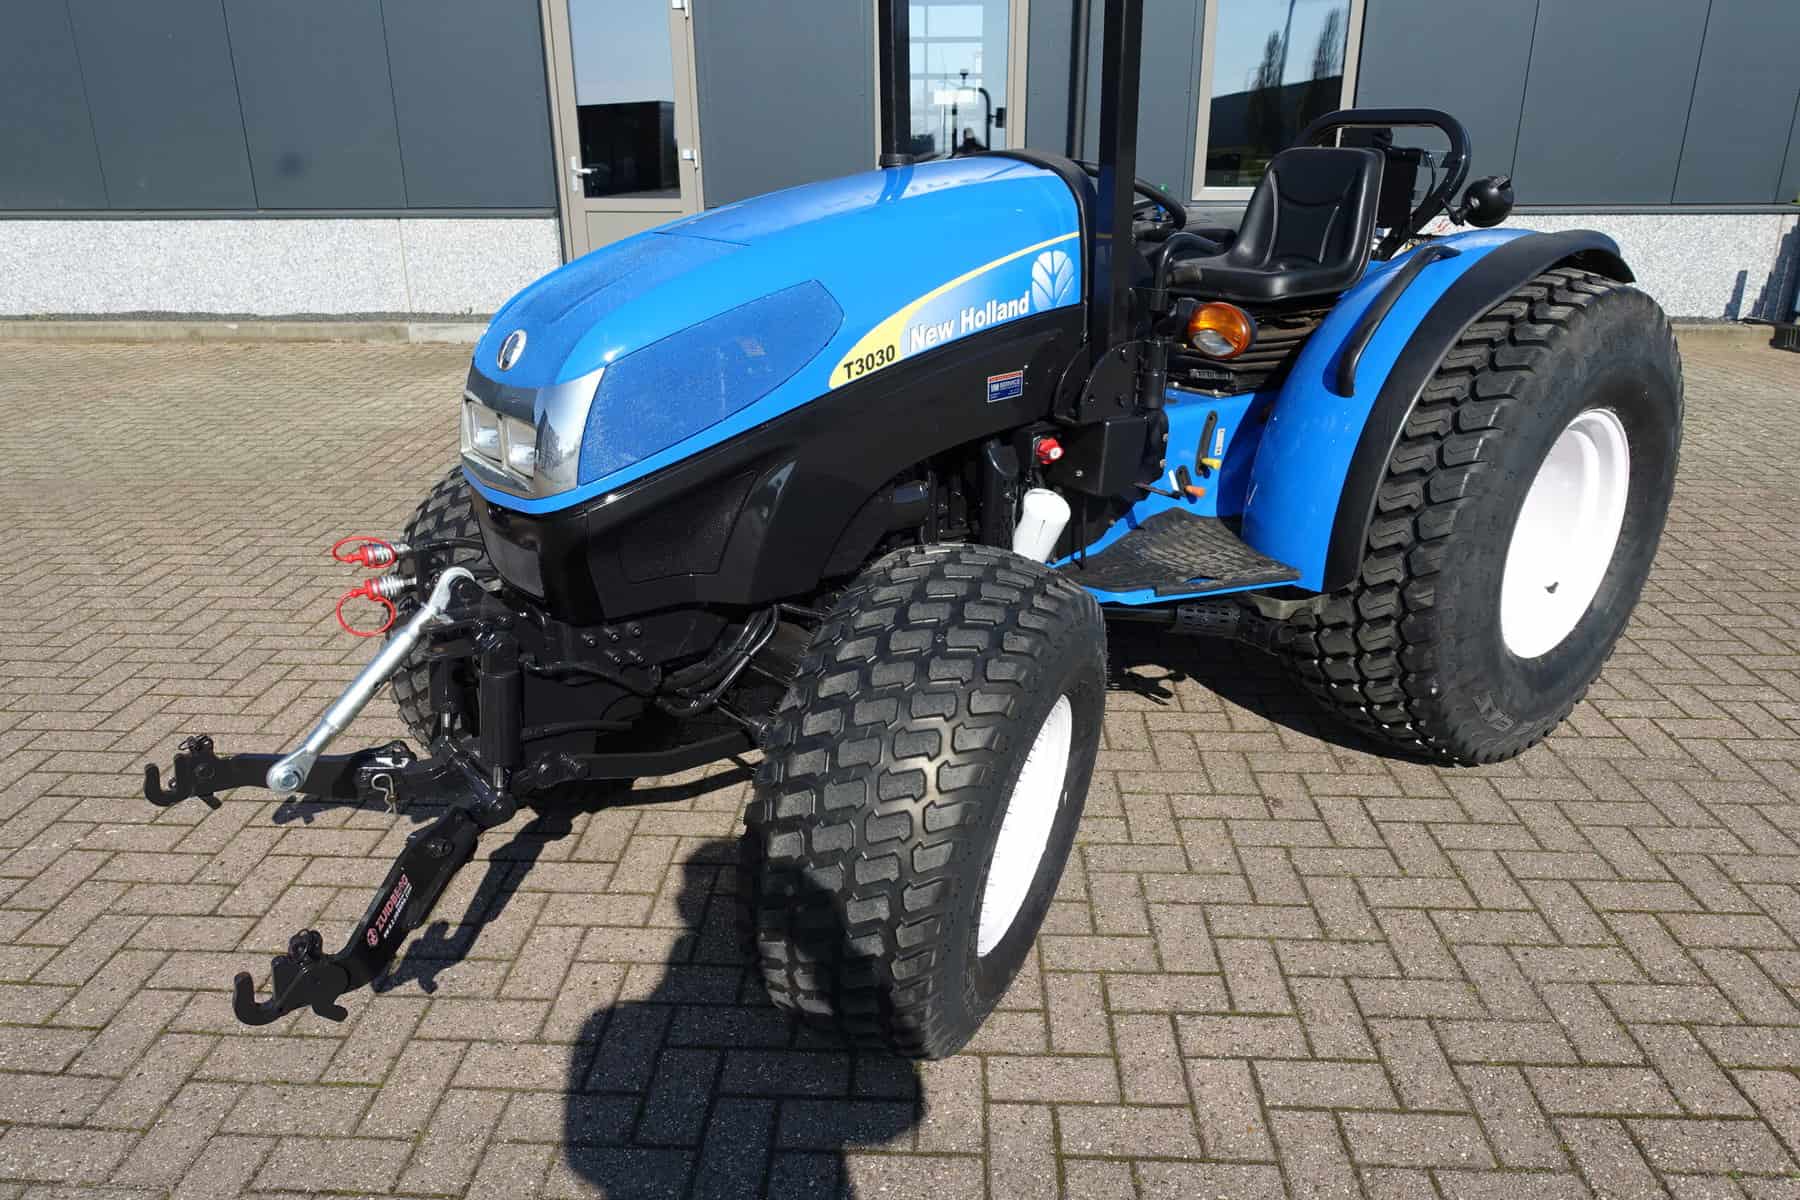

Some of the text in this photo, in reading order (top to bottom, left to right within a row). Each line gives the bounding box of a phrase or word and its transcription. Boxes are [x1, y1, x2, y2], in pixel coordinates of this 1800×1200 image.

[910, 292, 1029, 353] New Holland
[844, 344, 896, 380] T3030
[375, 873, 408, 932] ZUIDBERG
